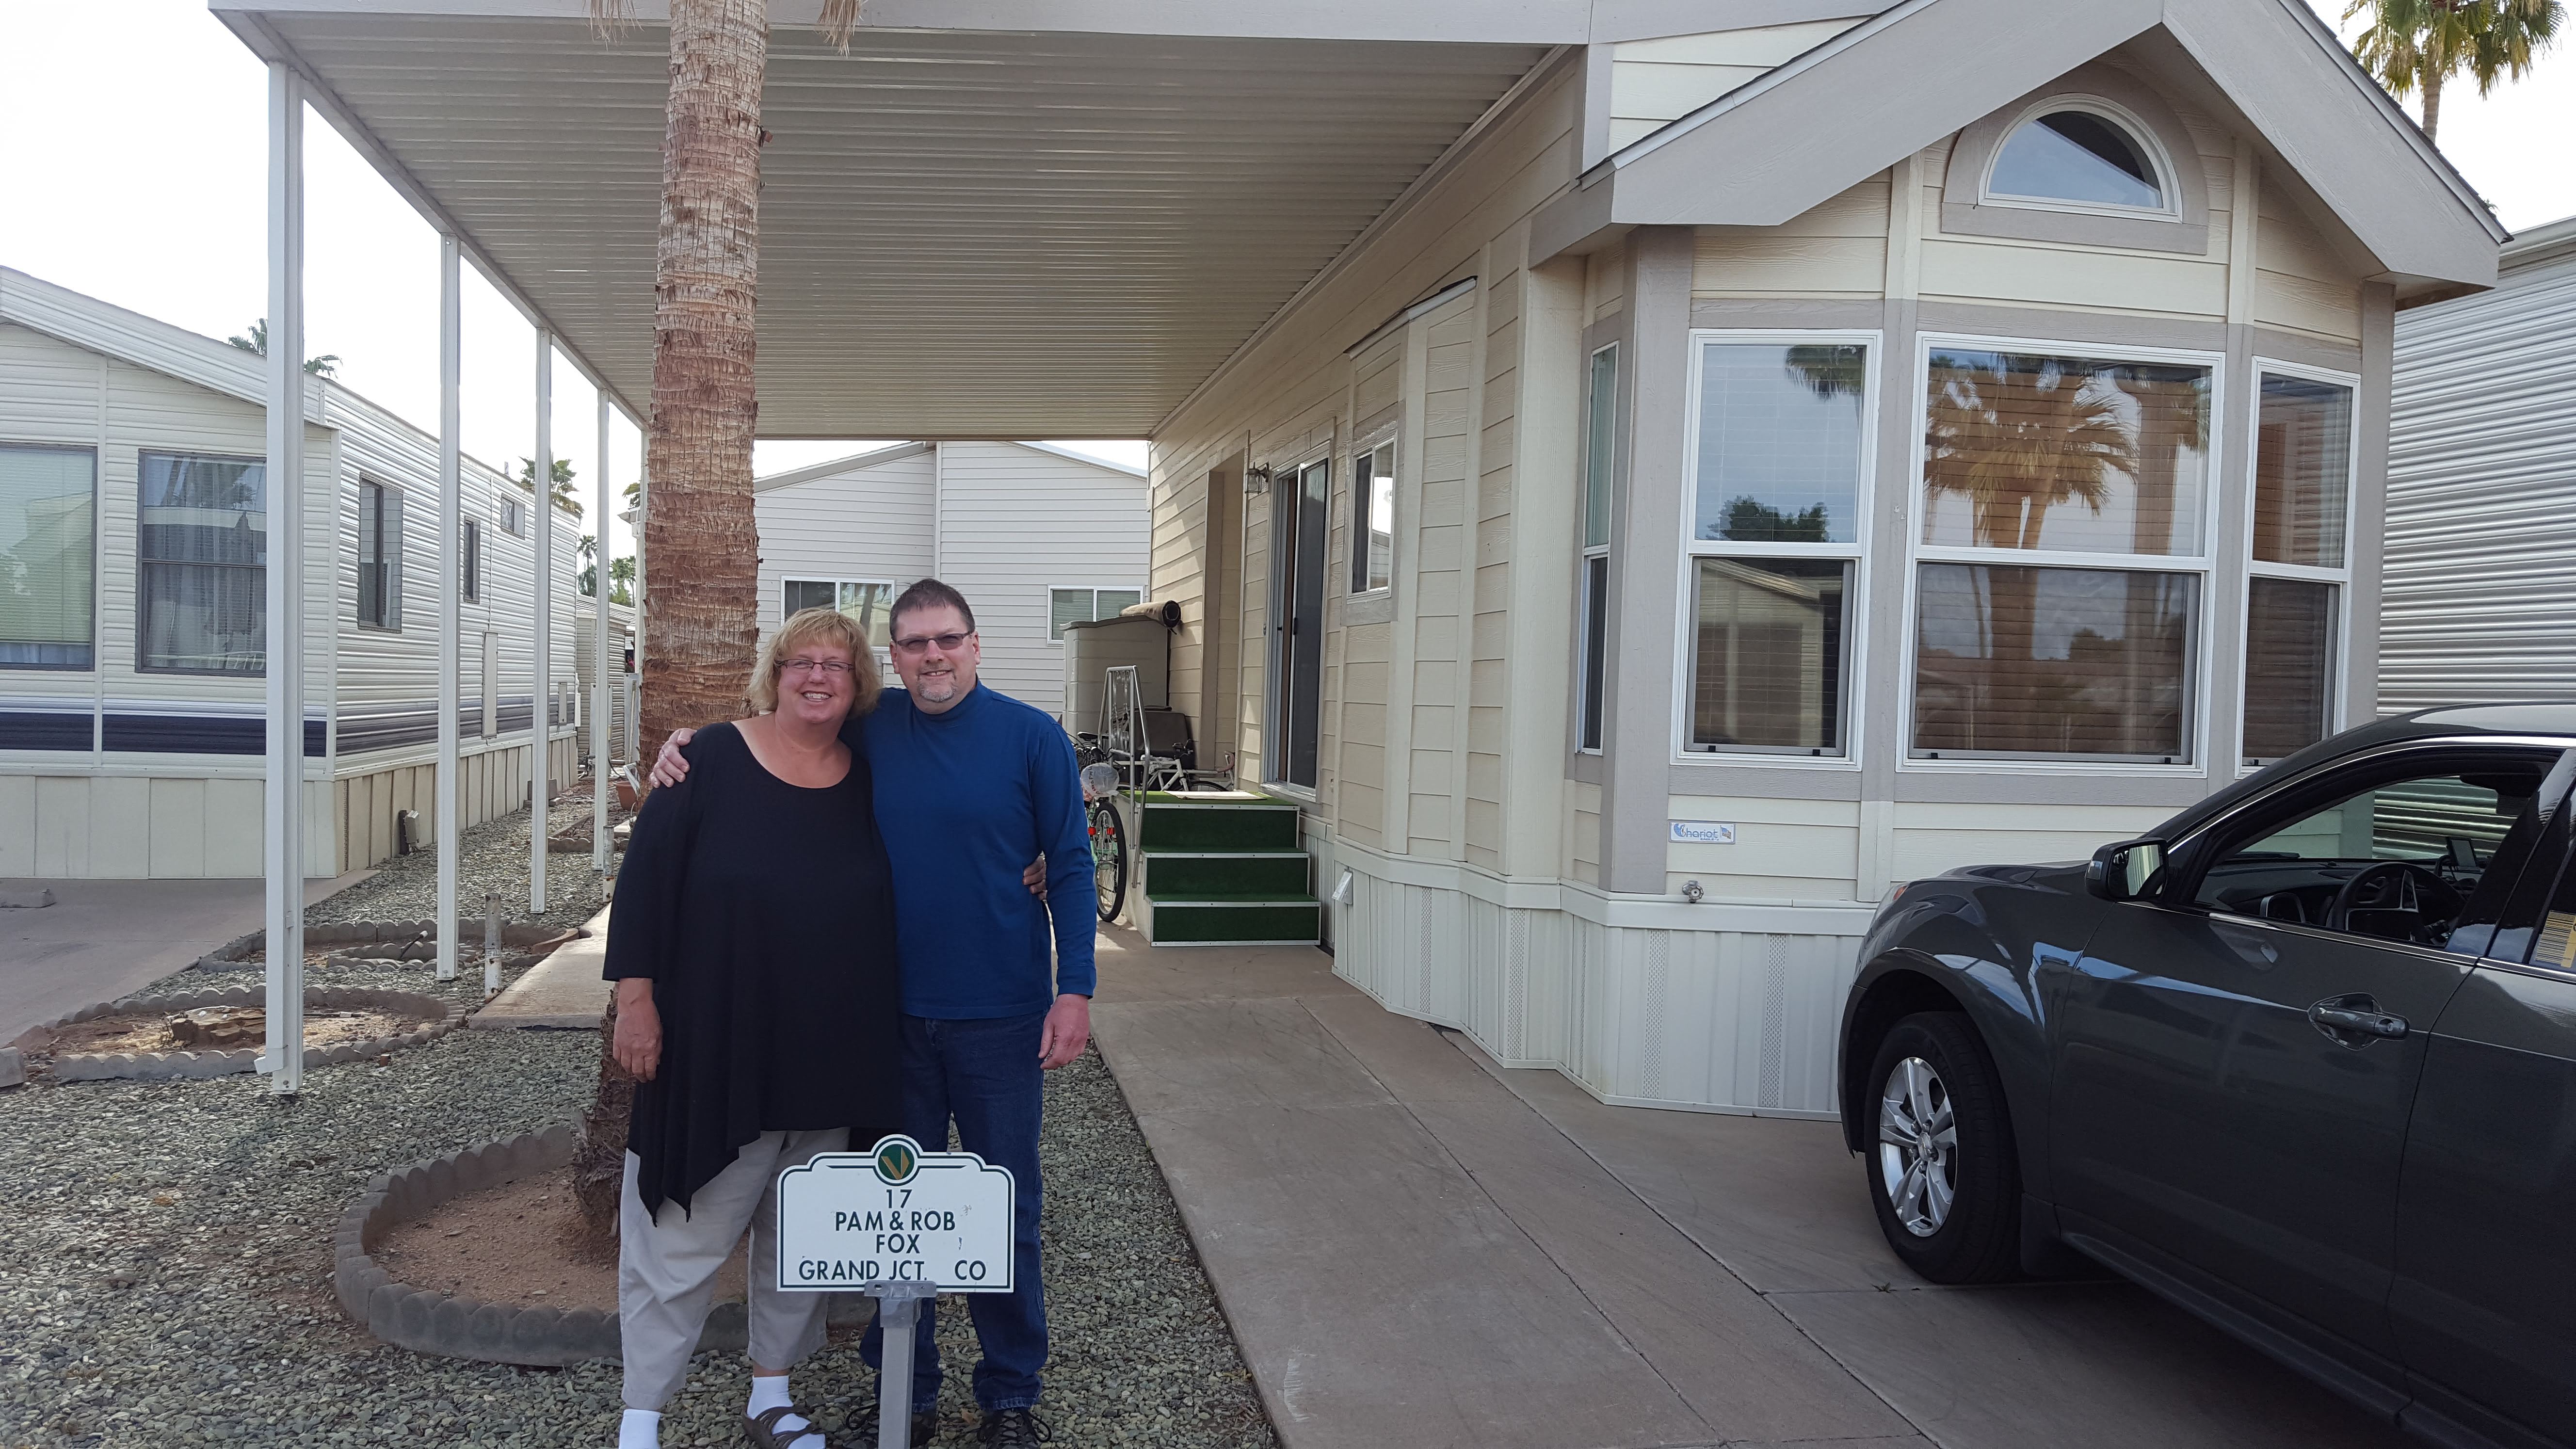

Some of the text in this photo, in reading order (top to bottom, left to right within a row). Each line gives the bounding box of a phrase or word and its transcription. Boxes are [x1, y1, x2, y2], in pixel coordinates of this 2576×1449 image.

[1673, 822, 1719, 838] Chariot
[886, 1189, 913, 1209] 17
[835, 1210, 956, 1231] PAM & ROB
[876, 1233, 921, 1254] FOX
[798, 1259, 987, 1281] GRAND JCT. CO
